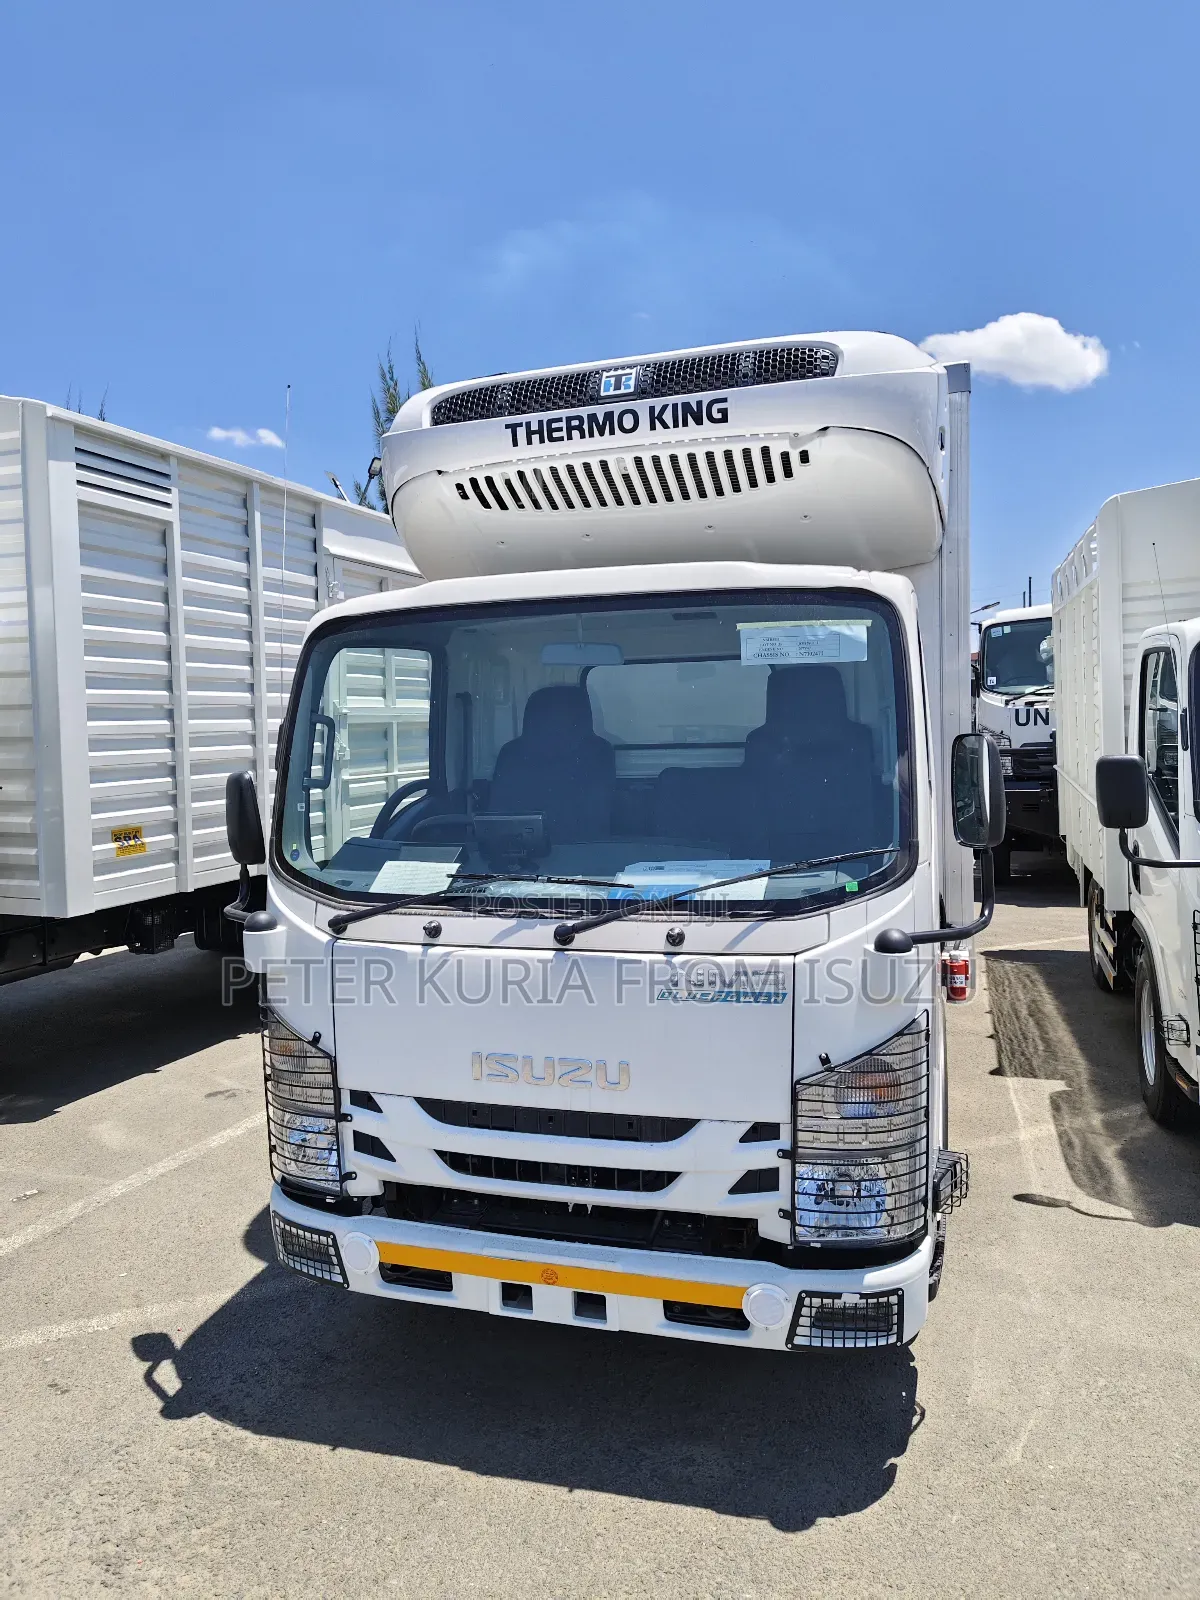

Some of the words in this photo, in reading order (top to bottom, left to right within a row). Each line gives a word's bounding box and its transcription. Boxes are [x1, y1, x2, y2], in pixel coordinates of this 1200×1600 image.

[504, 408, 640, 448] THERMO
[649, 397, 730, 431] KING
[1015, 708, 1050, 727] UN
[471, 1051, 632, 1092] ISUZU
